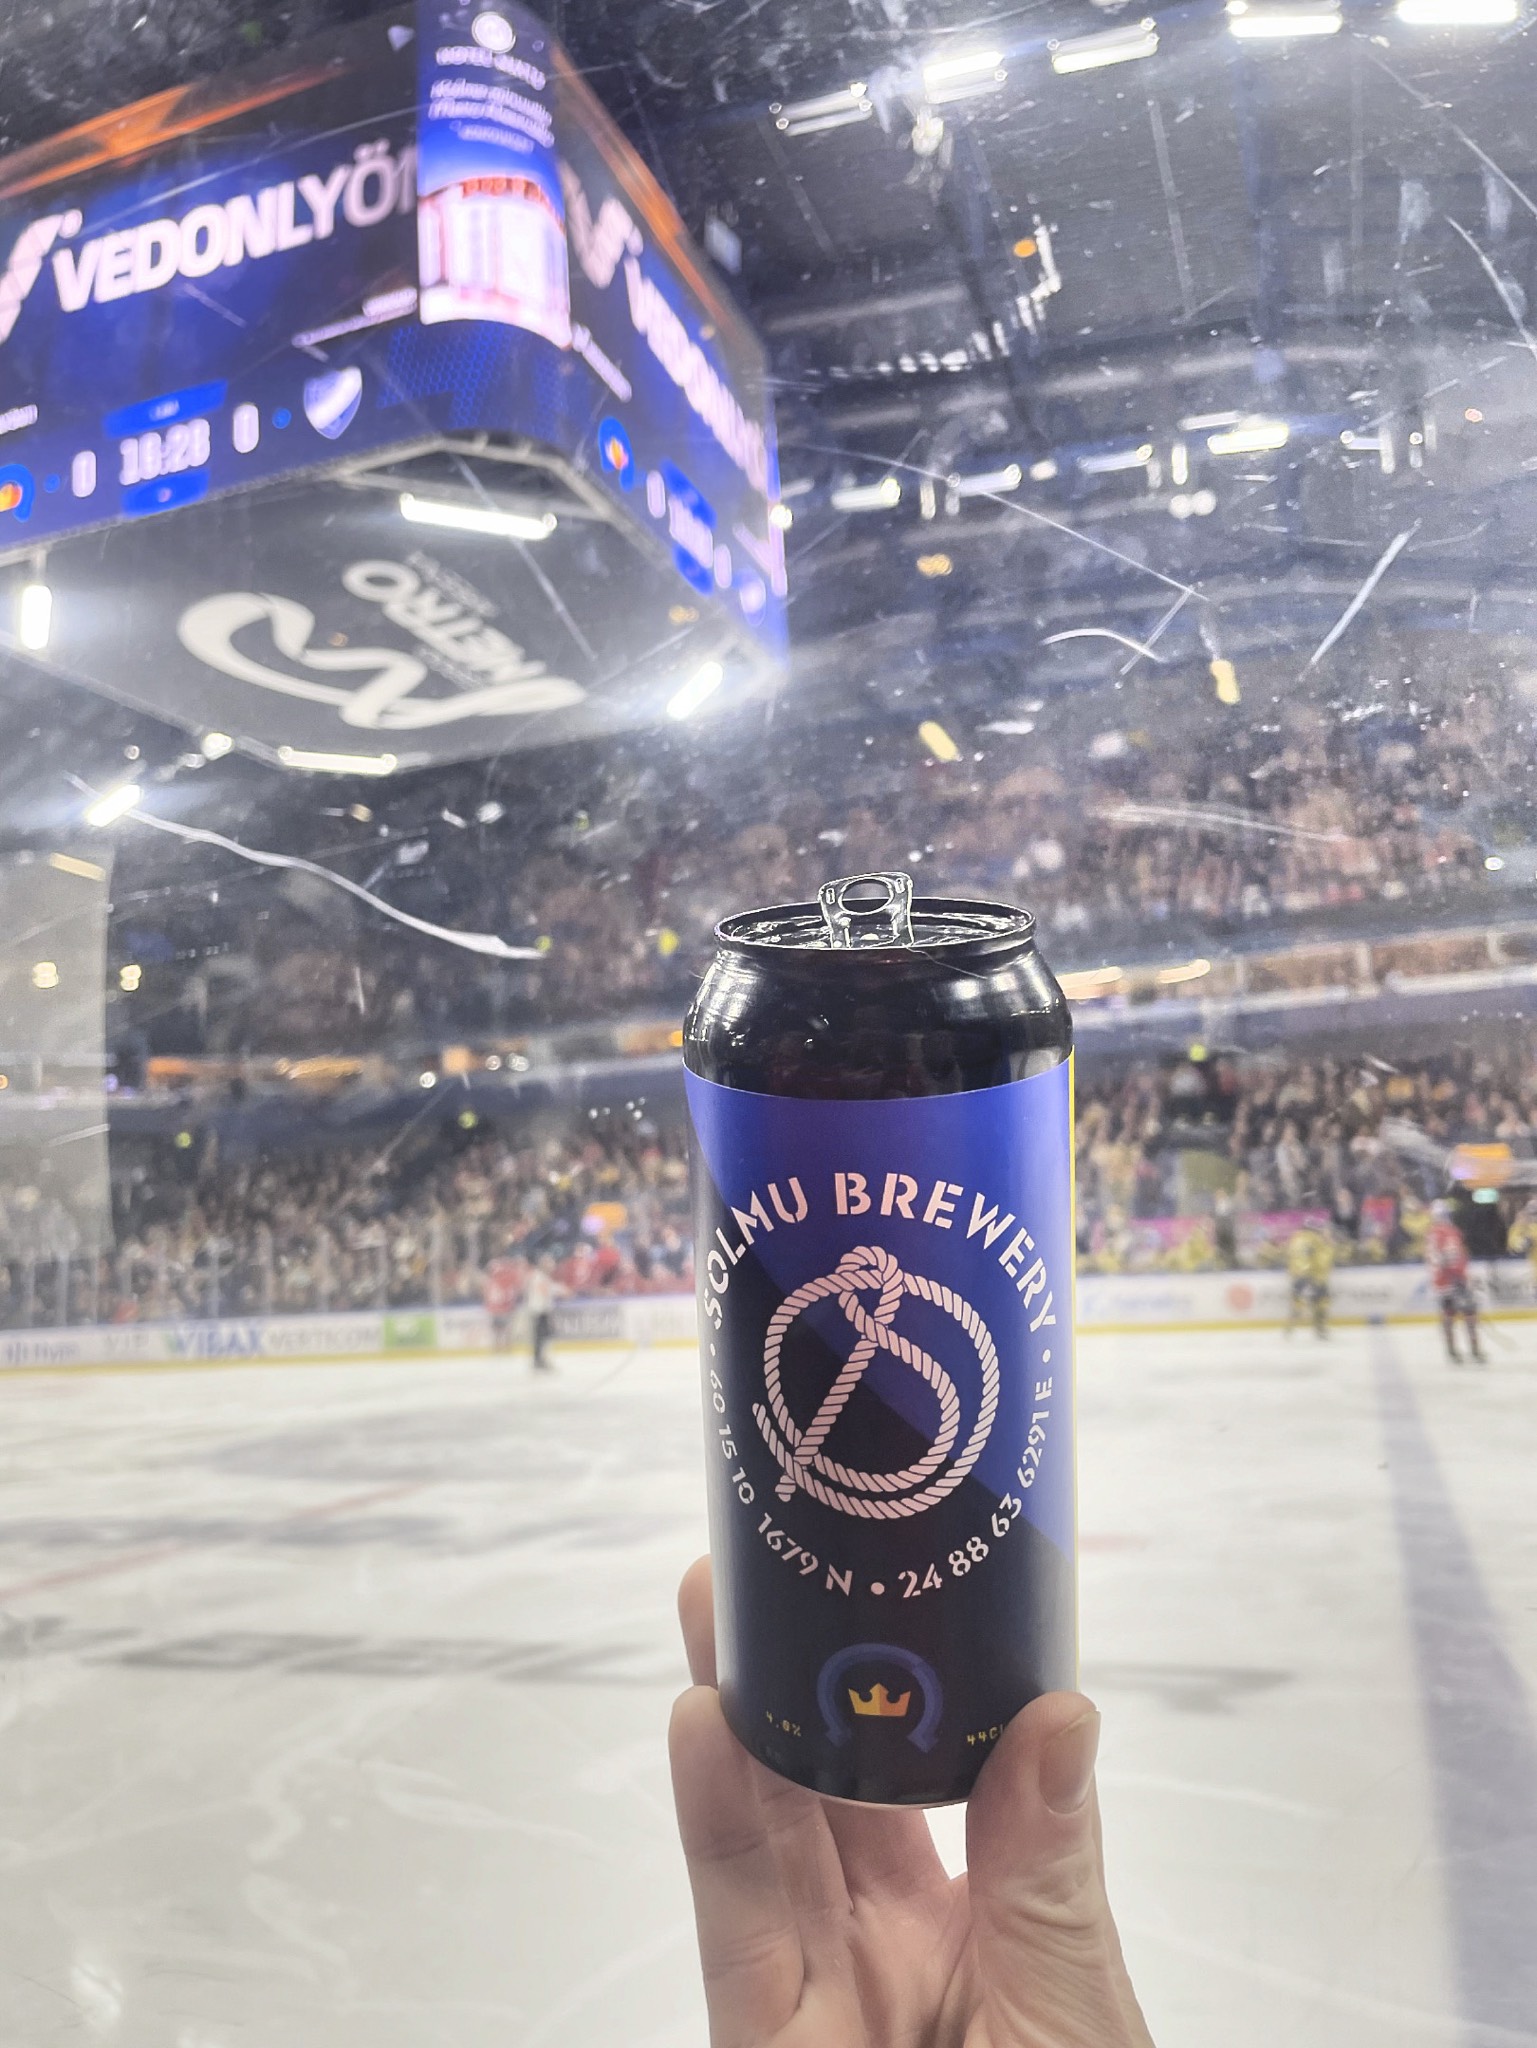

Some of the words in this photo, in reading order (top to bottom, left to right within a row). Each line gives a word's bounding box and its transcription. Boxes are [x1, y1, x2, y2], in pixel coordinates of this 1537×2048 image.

[704, 1176, 808, 1330] SOLMU
[834, 1172, 1057, 1333] BREWERY
[710, 1369, 726, 1414] 60
[719, 1424, 738, 1460] 15
[732, 1467, 755, 1505] 10
[758, 1512, 819, 1576] 1679
[826, 1563, 853, 1597] N
[898, 1563, 943, 1598] 24
[948, 1536, 990, 1577] 88
[991, 1492, 1022, 1538] 63
[1017, 1410, 1050, 1489] 6291
[1035, 1376, 1053, 1401] E
